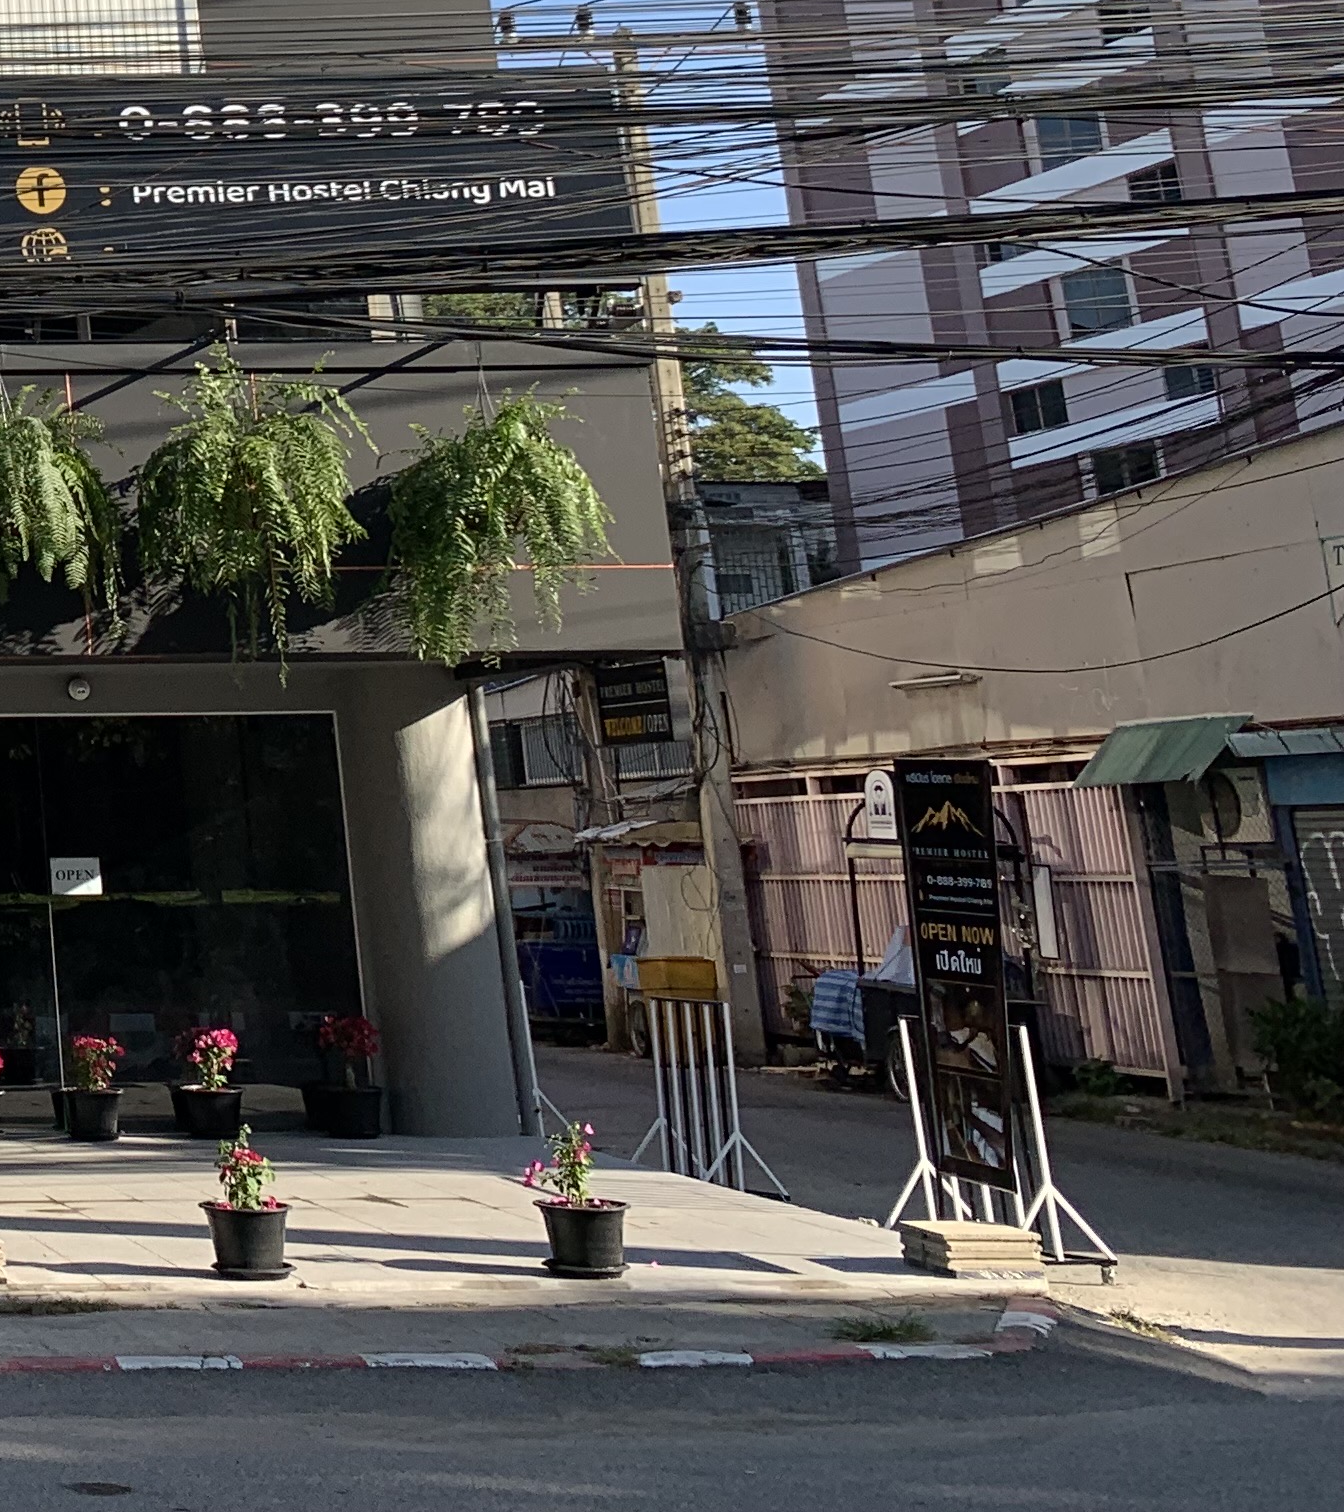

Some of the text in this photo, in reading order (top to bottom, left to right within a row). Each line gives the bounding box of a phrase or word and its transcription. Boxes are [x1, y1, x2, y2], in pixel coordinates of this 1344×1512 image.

[133, 179, 259, 204] Premier
[499, 175, 556, 199] Mai
[55, 869, 95, 881] OPEN
[921, 922, 994, 946] OPEN NOW
[935, 947, 982, 975] เปิดใหม่
